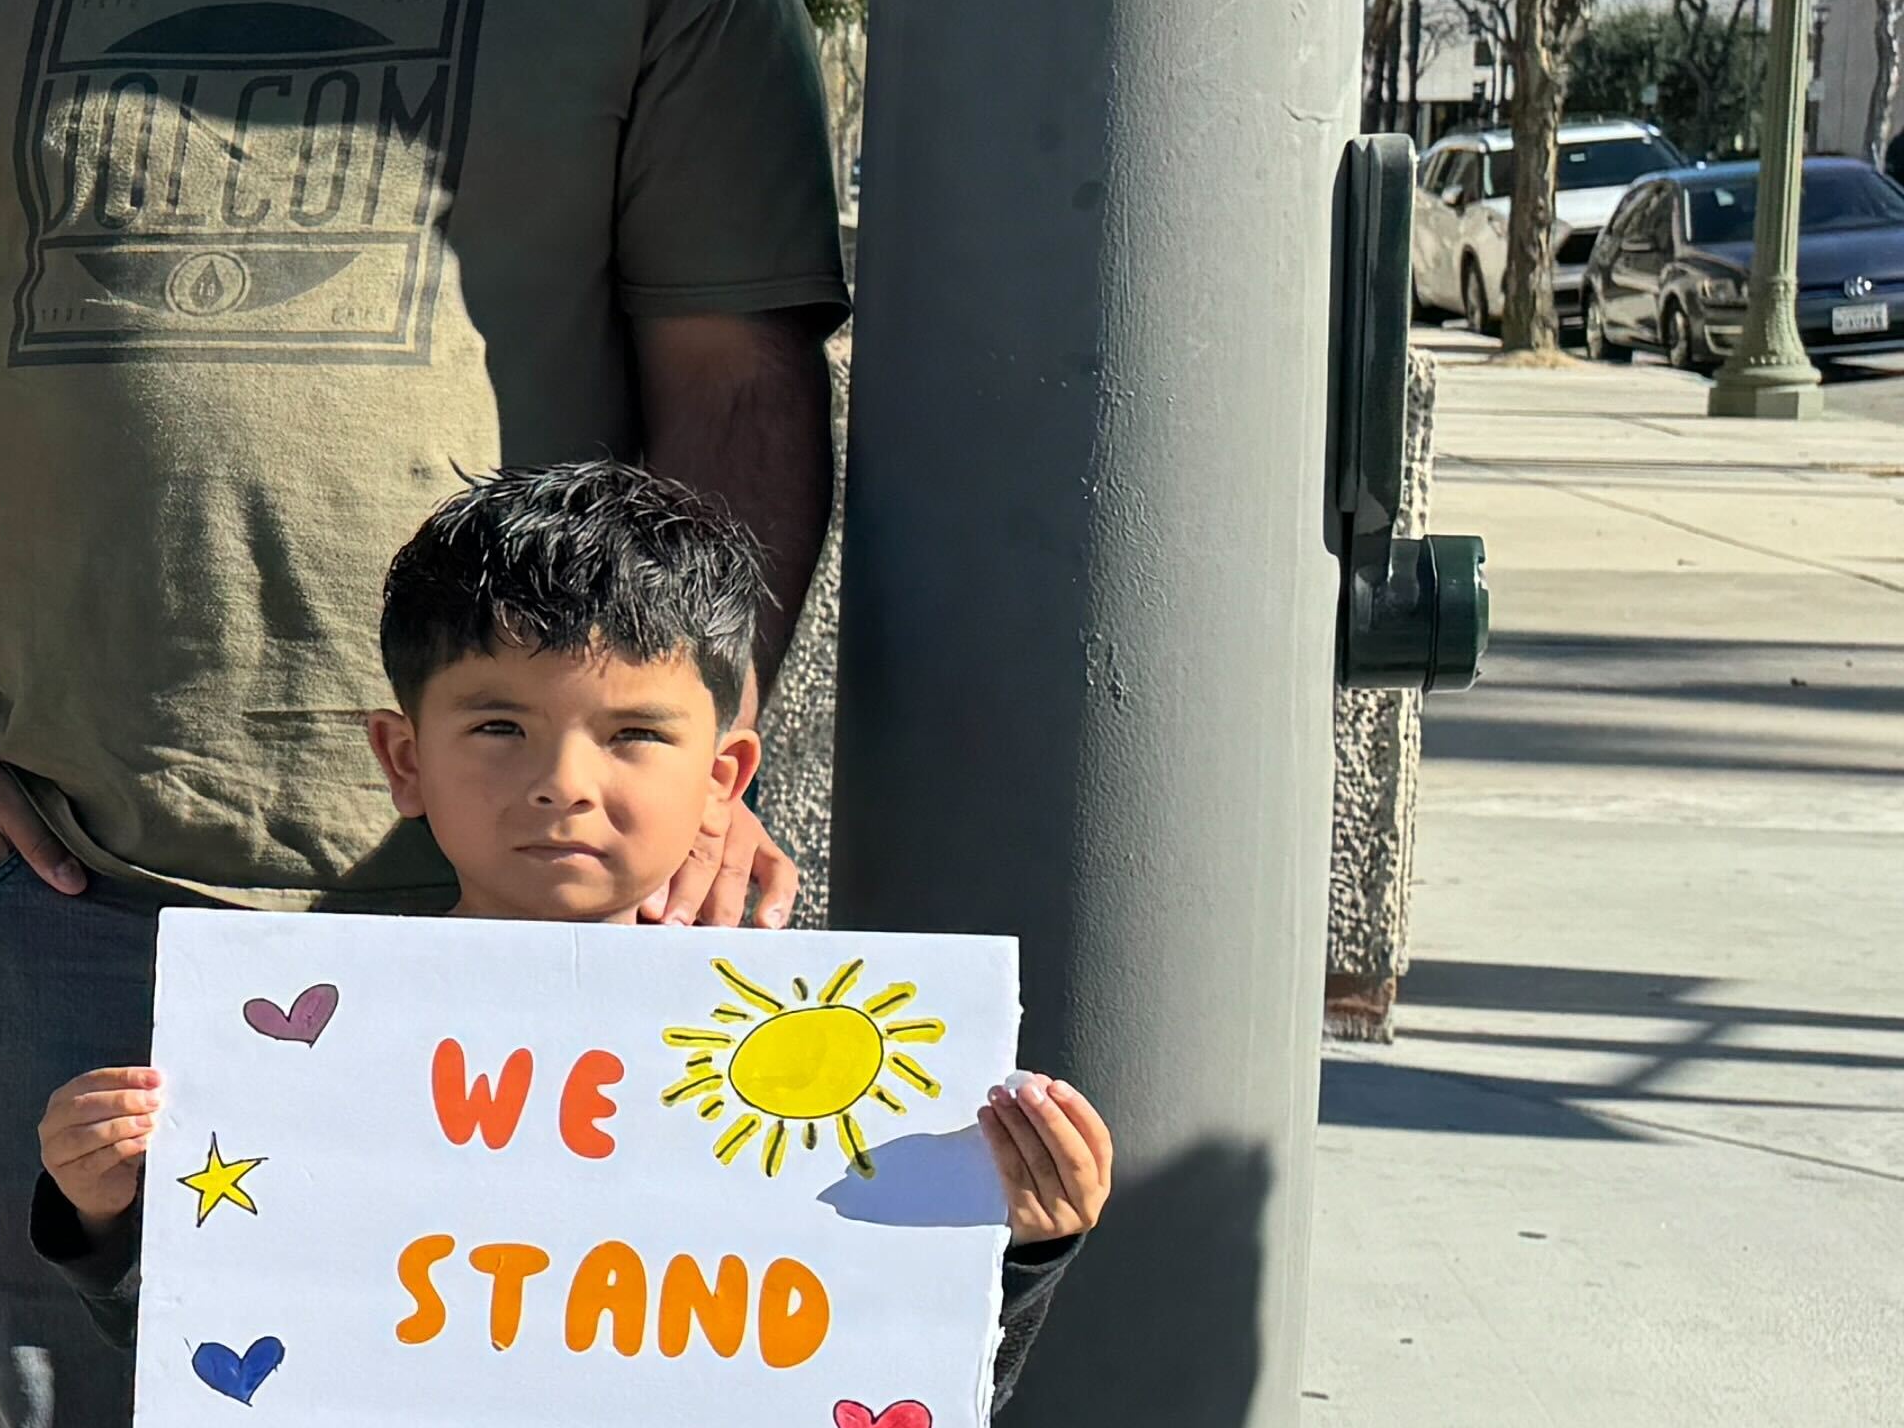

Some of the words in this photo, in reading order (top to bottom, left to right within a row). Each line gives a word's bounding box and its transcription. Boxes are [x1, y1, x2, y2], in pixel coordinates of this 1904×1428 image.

[32, 62, 450, 235] VOLCOM
[434, 1040, 623, 1158] WE
[397, 1235, 830, 1368] STAND
